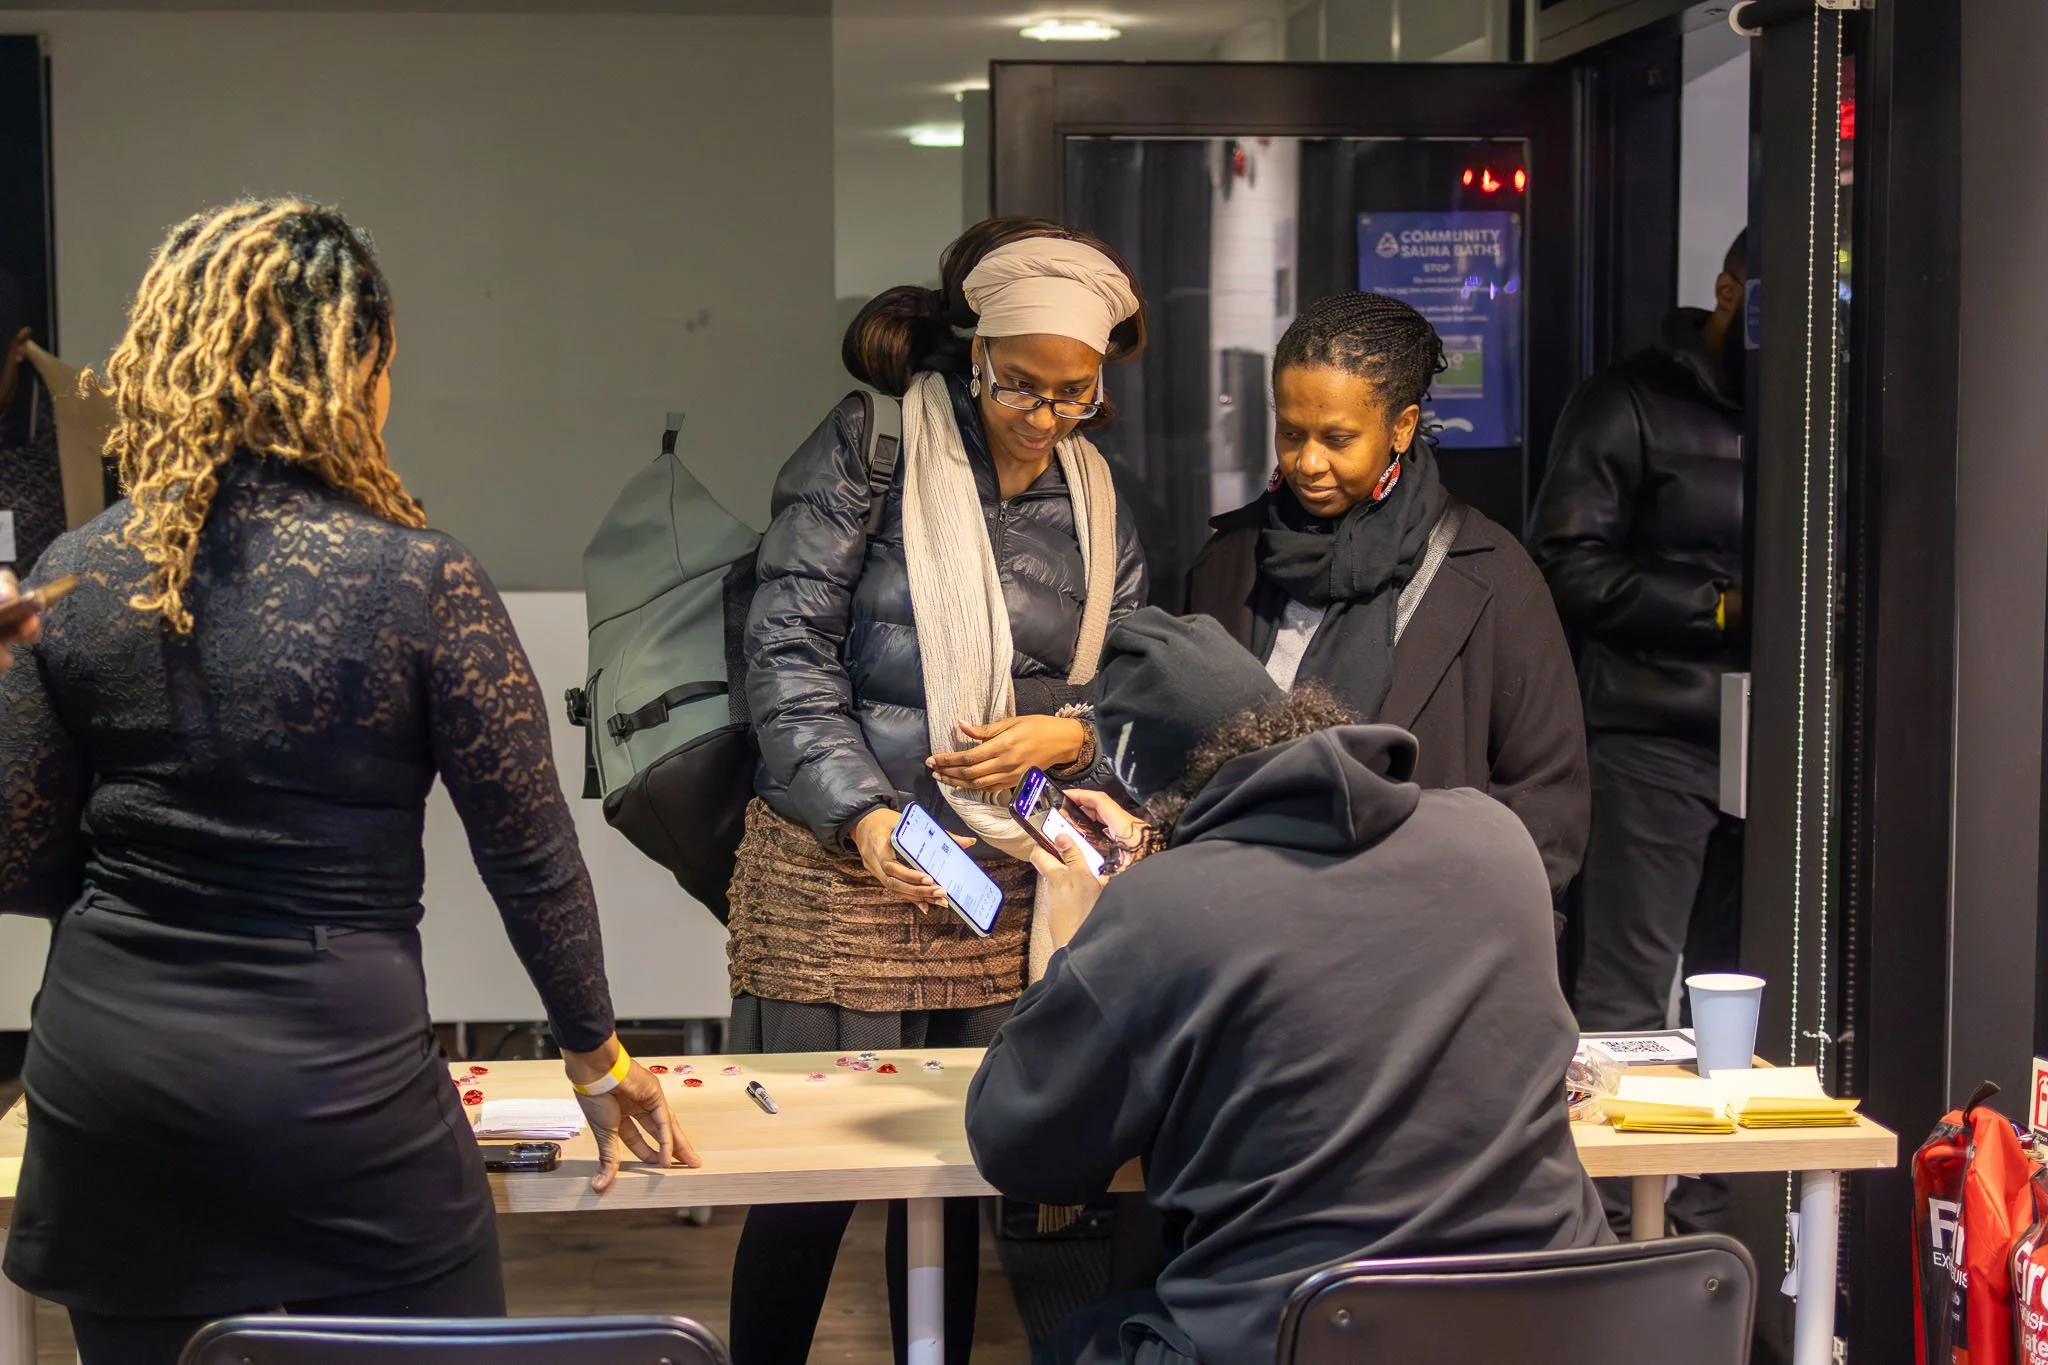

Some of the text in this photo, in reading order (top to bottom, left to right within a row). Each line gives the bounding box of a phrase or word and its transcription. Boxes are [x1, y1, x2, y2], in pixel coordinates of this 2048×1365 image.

[1401, 229, 1501, 243] COMMUNITY
[1401, 243, 1501, 257] SAUNA BATHS
[1423, 263, 1451, 273] STOP
